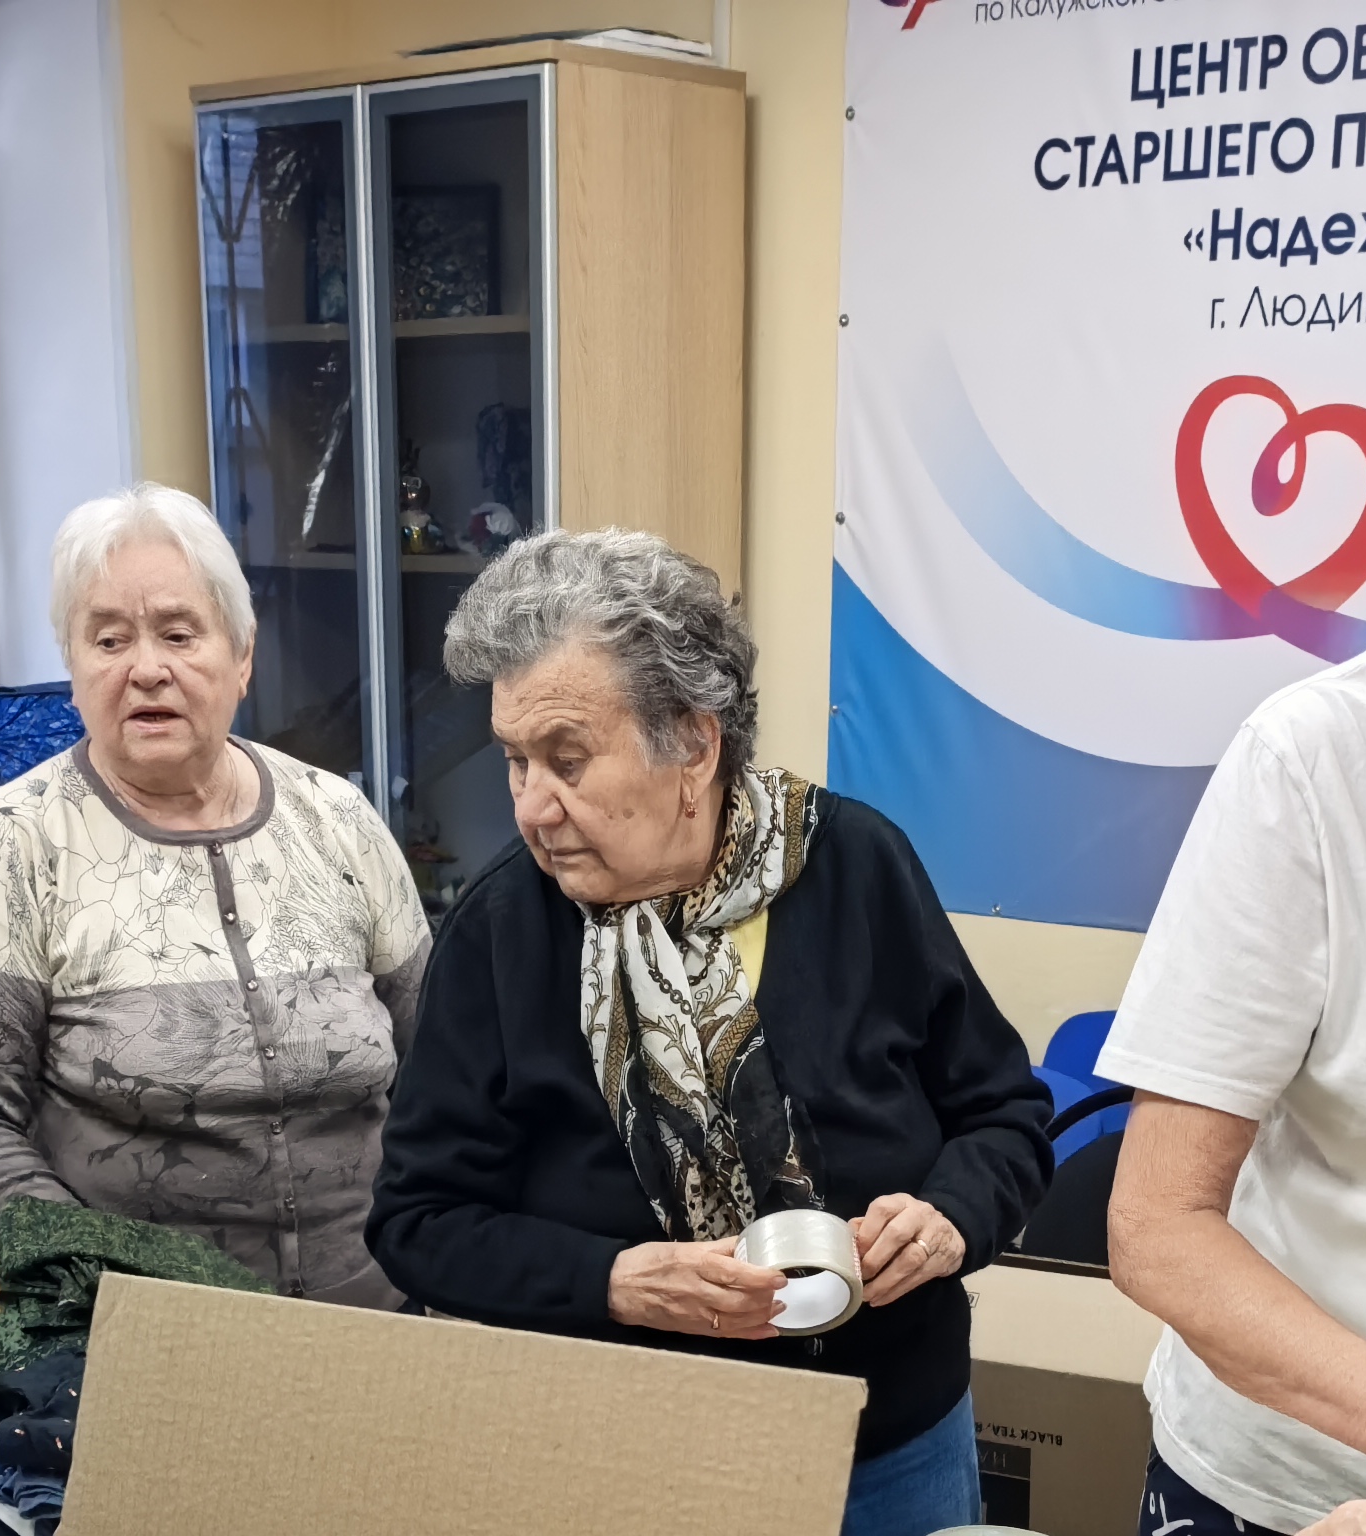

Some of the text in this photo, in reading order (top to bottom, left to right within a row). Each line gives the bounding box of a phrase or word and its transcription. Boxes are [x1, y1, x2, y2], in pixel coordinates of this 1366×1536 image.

[975, 1, 1004, 22] по
[1130, 33, 1288, 109] ЦЕНТР
[1034, 117, 1315, 191] СТАРШЕГО
[1210, 298, 1226, 330] г.
[1020, 1429, 1063, 1446] BLACK
